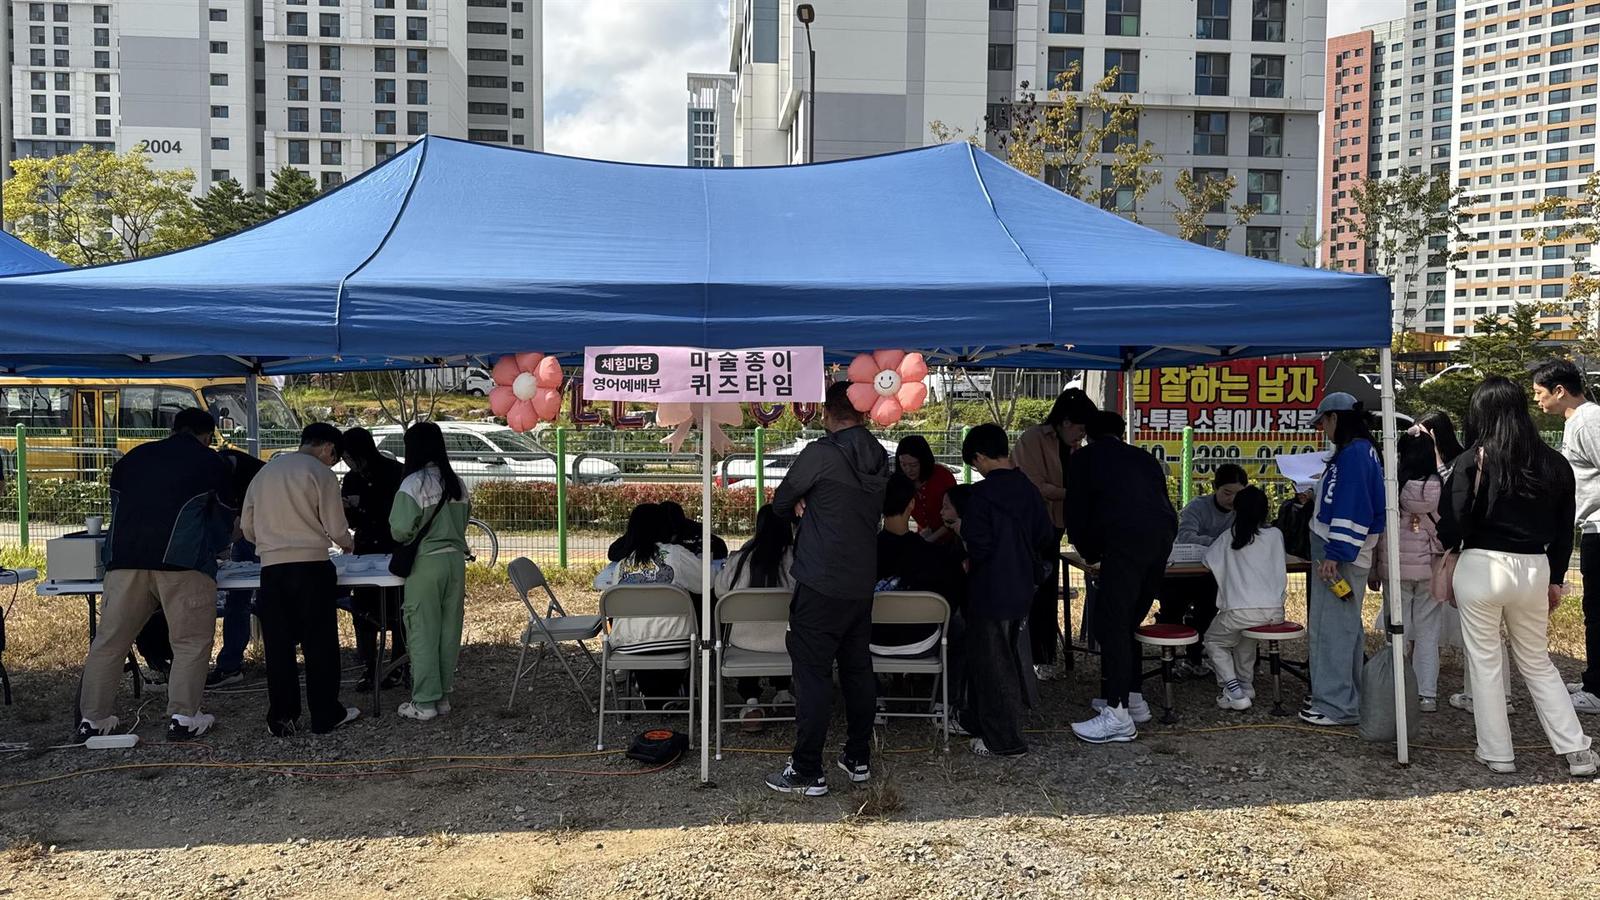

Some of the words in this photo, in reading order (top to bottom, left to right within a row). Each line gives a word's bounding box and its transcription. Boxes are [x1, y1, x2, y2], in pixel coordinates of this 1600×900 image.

[140, 139, 182, 154] 2004
[600, 356, 653, 372] 체험마당
[690, 350, 792, 373] 마술종이
[592, 377, 662, 394] 영어예배부
[690, 374, 793, 397] 퀴즈타임
[1160, 365, 1249, 403] 잘하는
[1258, 366, 1318, 403] 남자
[1194, 407, 1273, 433] 소형이사
[1278, 408, 1317, 434] 전문
